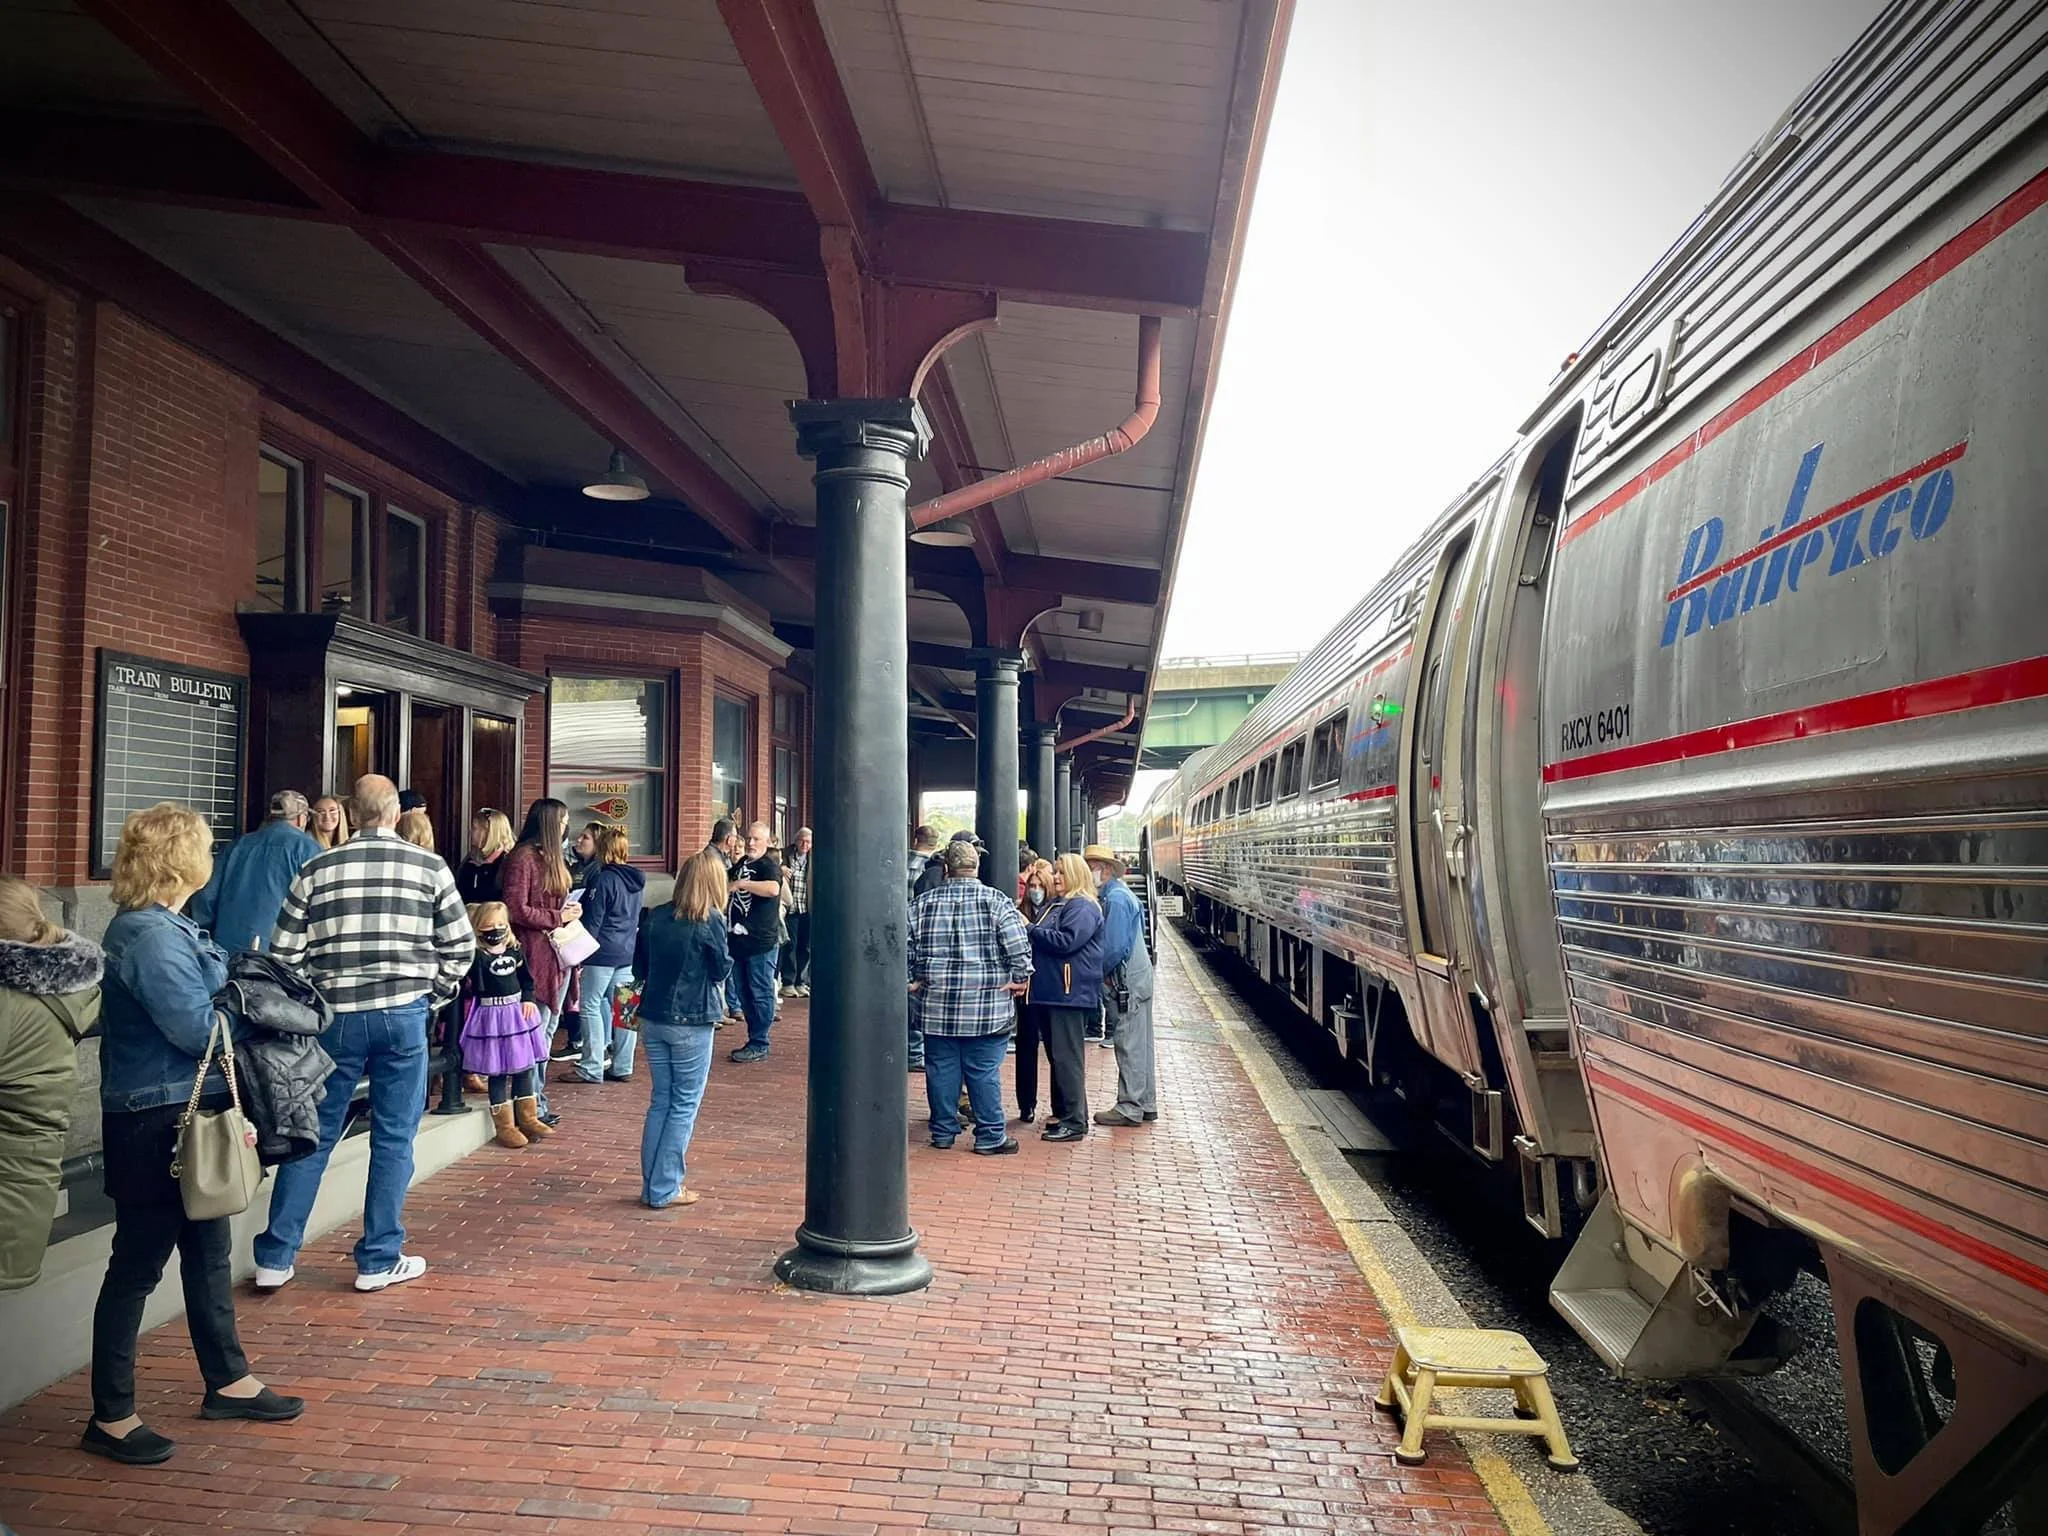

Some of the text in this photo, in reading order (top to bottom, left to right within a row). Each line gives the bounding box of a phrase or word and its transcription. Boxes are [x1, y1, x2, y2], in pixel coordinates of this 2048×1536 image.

[1660, 441, 1955, 648] Railexco
[115, 666, 232, 700] TRAIN BULLETIN
[1561, 704, 1630, 752] RXCX 6401
[585, 782, 630, 794] TICKET
